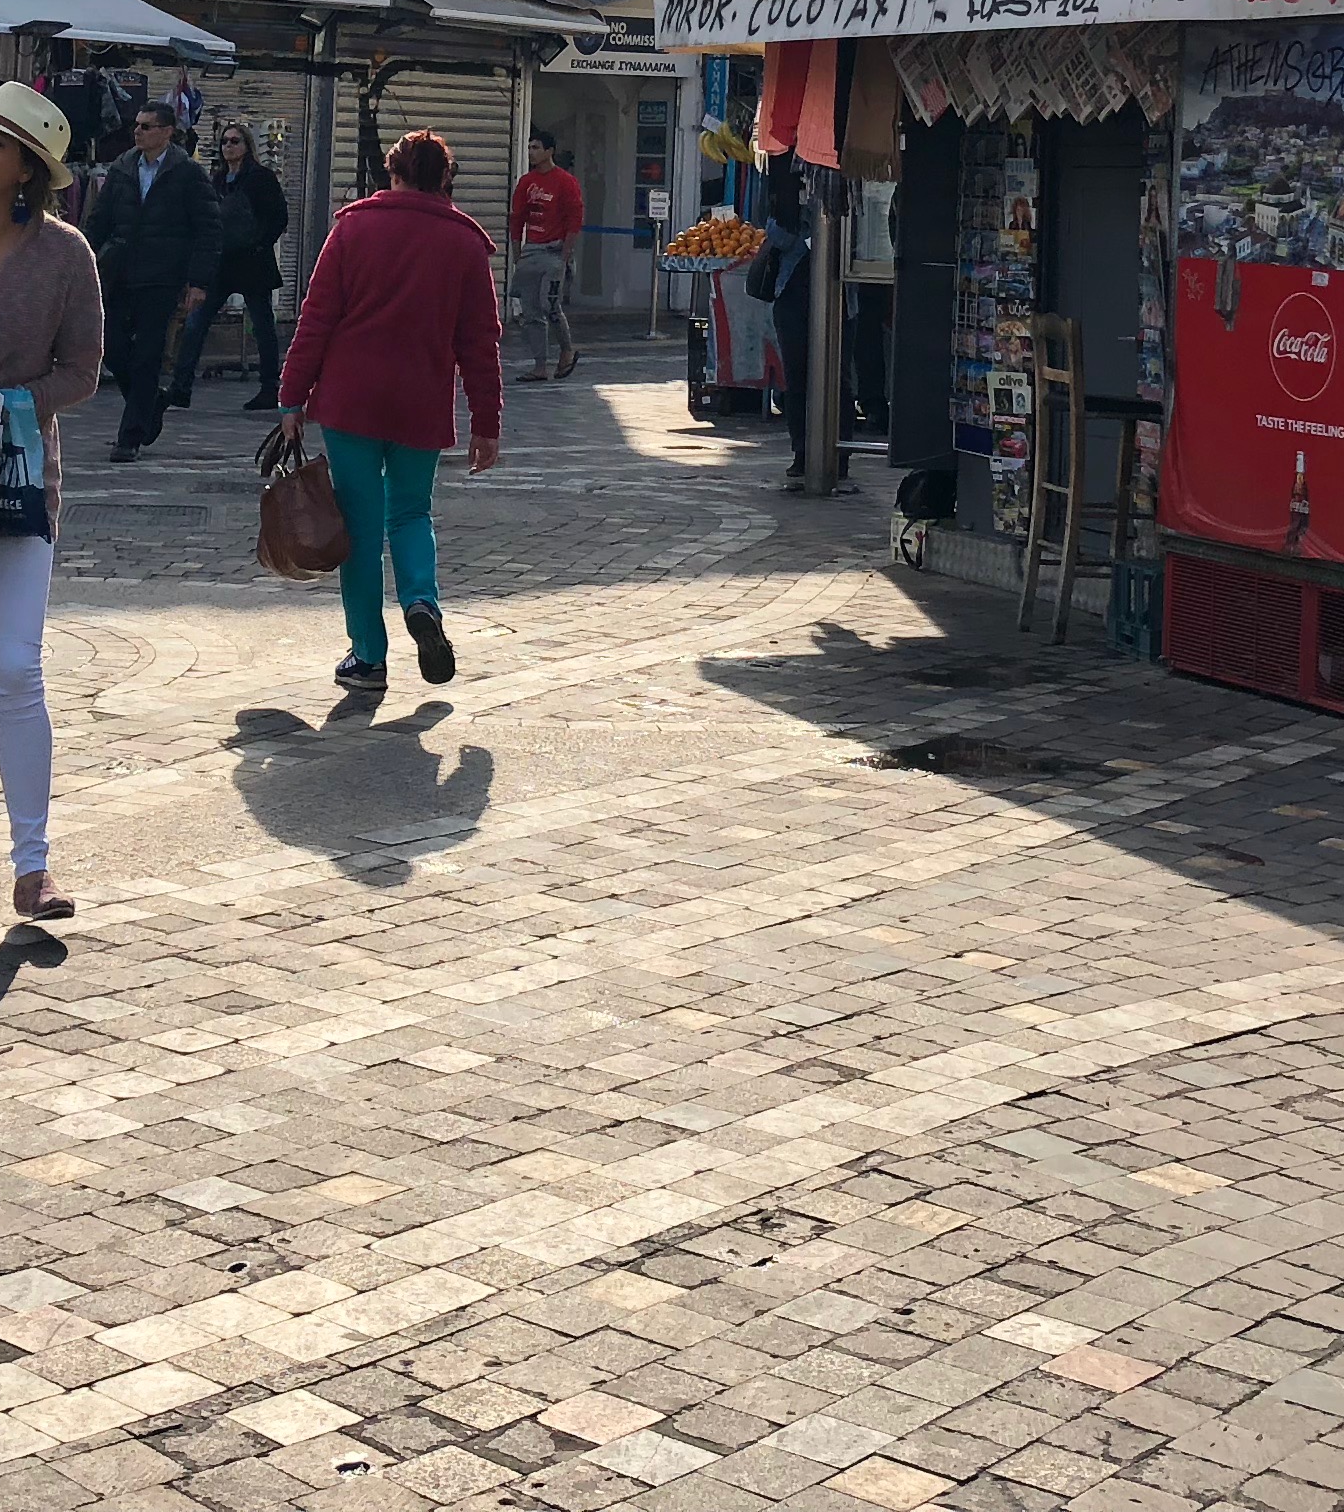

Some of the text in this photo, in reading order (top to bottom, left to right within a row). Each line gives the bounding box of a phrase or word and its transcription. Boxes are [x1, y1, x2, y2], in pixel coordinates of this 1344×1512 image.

[610, 21, 627, 33] NO
[609, 34, 655, 47] COMMISS
[570, 58, 616, 71] EXCHANGE
[998, 375, 1024, 387] olive
[1256, 414, 1285, 430] TASTE
[1287, 419, 1305, 433] THE
